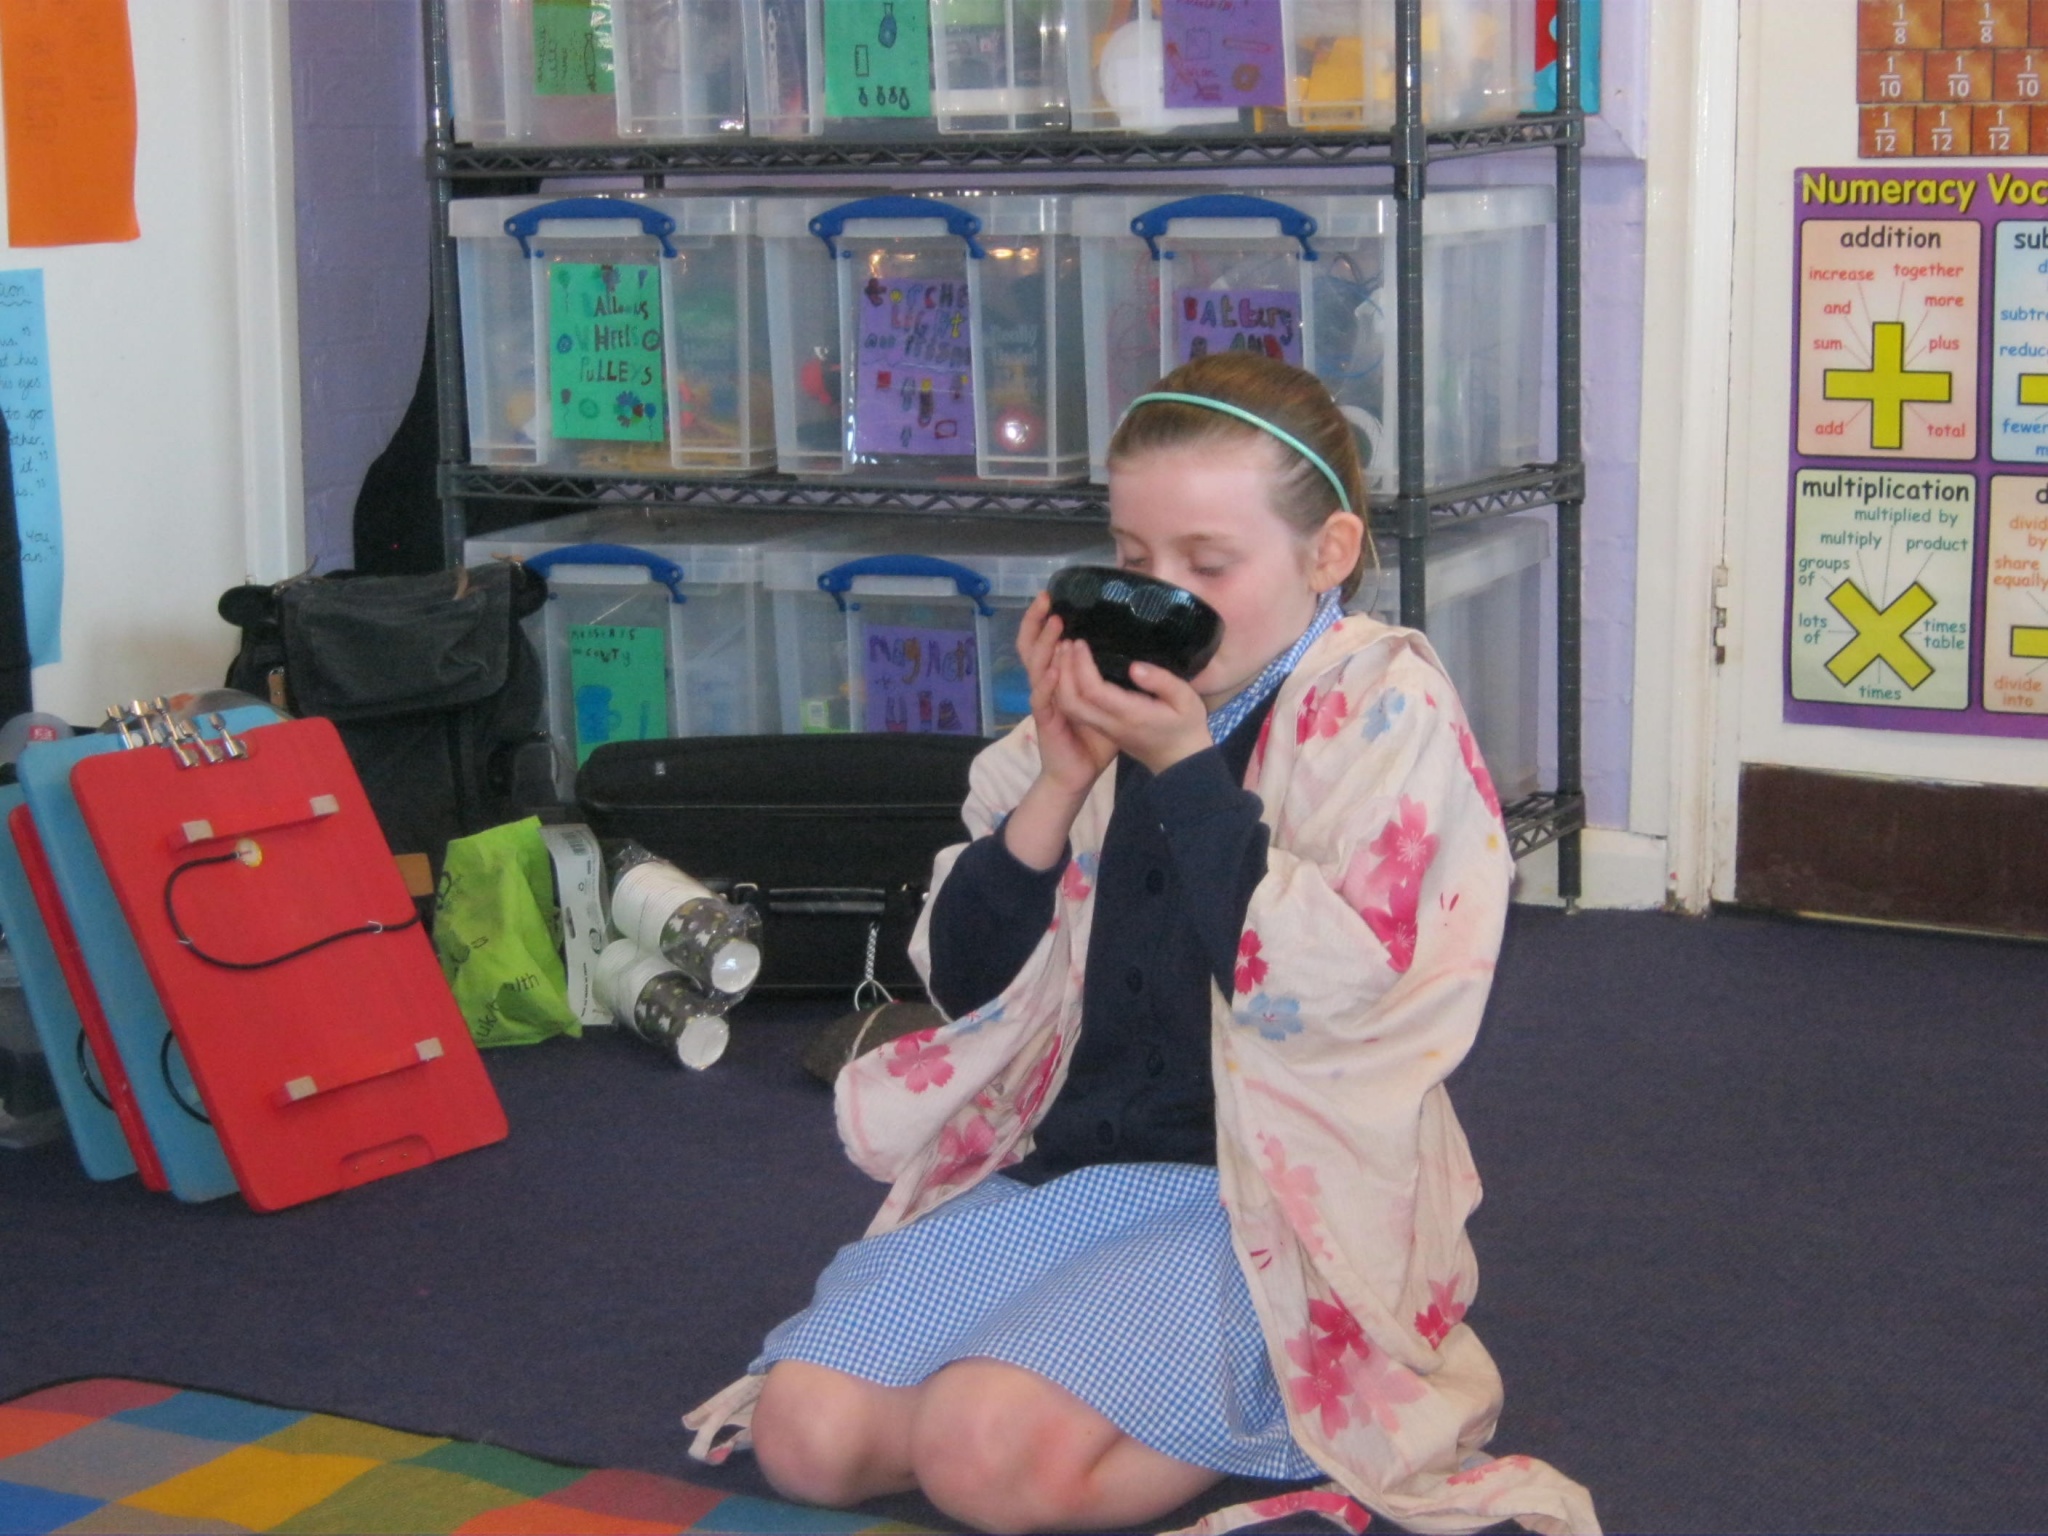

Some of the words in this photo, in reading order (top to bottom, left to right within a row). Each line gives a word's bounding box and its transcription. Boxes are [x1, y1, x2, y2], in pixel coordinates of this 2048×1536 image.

[1983, 2, 1991, 18] 1
[1894, 27, 1906, 44] 8
[1980, 26, 1993, 43] 8
[1886, 55, 1895, 73] 1
[1955, 55, 1963, 73] 1
[2024, 54, 2032, 72] 1
[1879, 80, 1901, 98] 10
[1948, 80, 1970, 98] 10
[2016, 79, 2039, 97] 10
[1883, 110, 1890, 127] 1
[1939, 109, 1947, 127] 1
[1996, 108, 2004, 125] 1
[1874, 135, 1896, 152] 12
[1931, 134, 1953, 151] 12
[1988, 133, 2010, 150] 12
[1801, 171, 1976, 213] Numeracy
[1839, 225, 1942, 249] addition
[1808, 266, 1875, 281] increase
[1893, 262, 1964, 279] together
[1823, 300, 1851, 315] and
[1924, 294, 1964, 307] more
[1813, 338, 1843, 350] sum
[1928, 335, 1960, 354] plus
[1814, 421, 1844, 435] add
[1926, 423, 1966, 438] total
[1802, 475, 1970, 505] multiplication
[1853, 506, 1932, 526] multiplied
[1938, 509, 1959, 528] by
[1820, 531, 1882, 549] multiply
[1905, 537, 1968, 552] product
[2027, 533, 2048, 550] by
[1798, 557, 1851, 574] groups
[1994, 556, 2041, 571] share
[1798, 571, 1817, 586] of
[1993, 573, 2048, 592] equally
[1799, 613, 1827, 628] lots
[1923, 618, 1967, 634] times
[1803, 629, 1821, 645] of
[1924, 634, 1966, 650] table
[1859, 684, 1902, 700] times
[1993, 676, 2042, 692] divide
[2002, 694, 2035, 708] into
